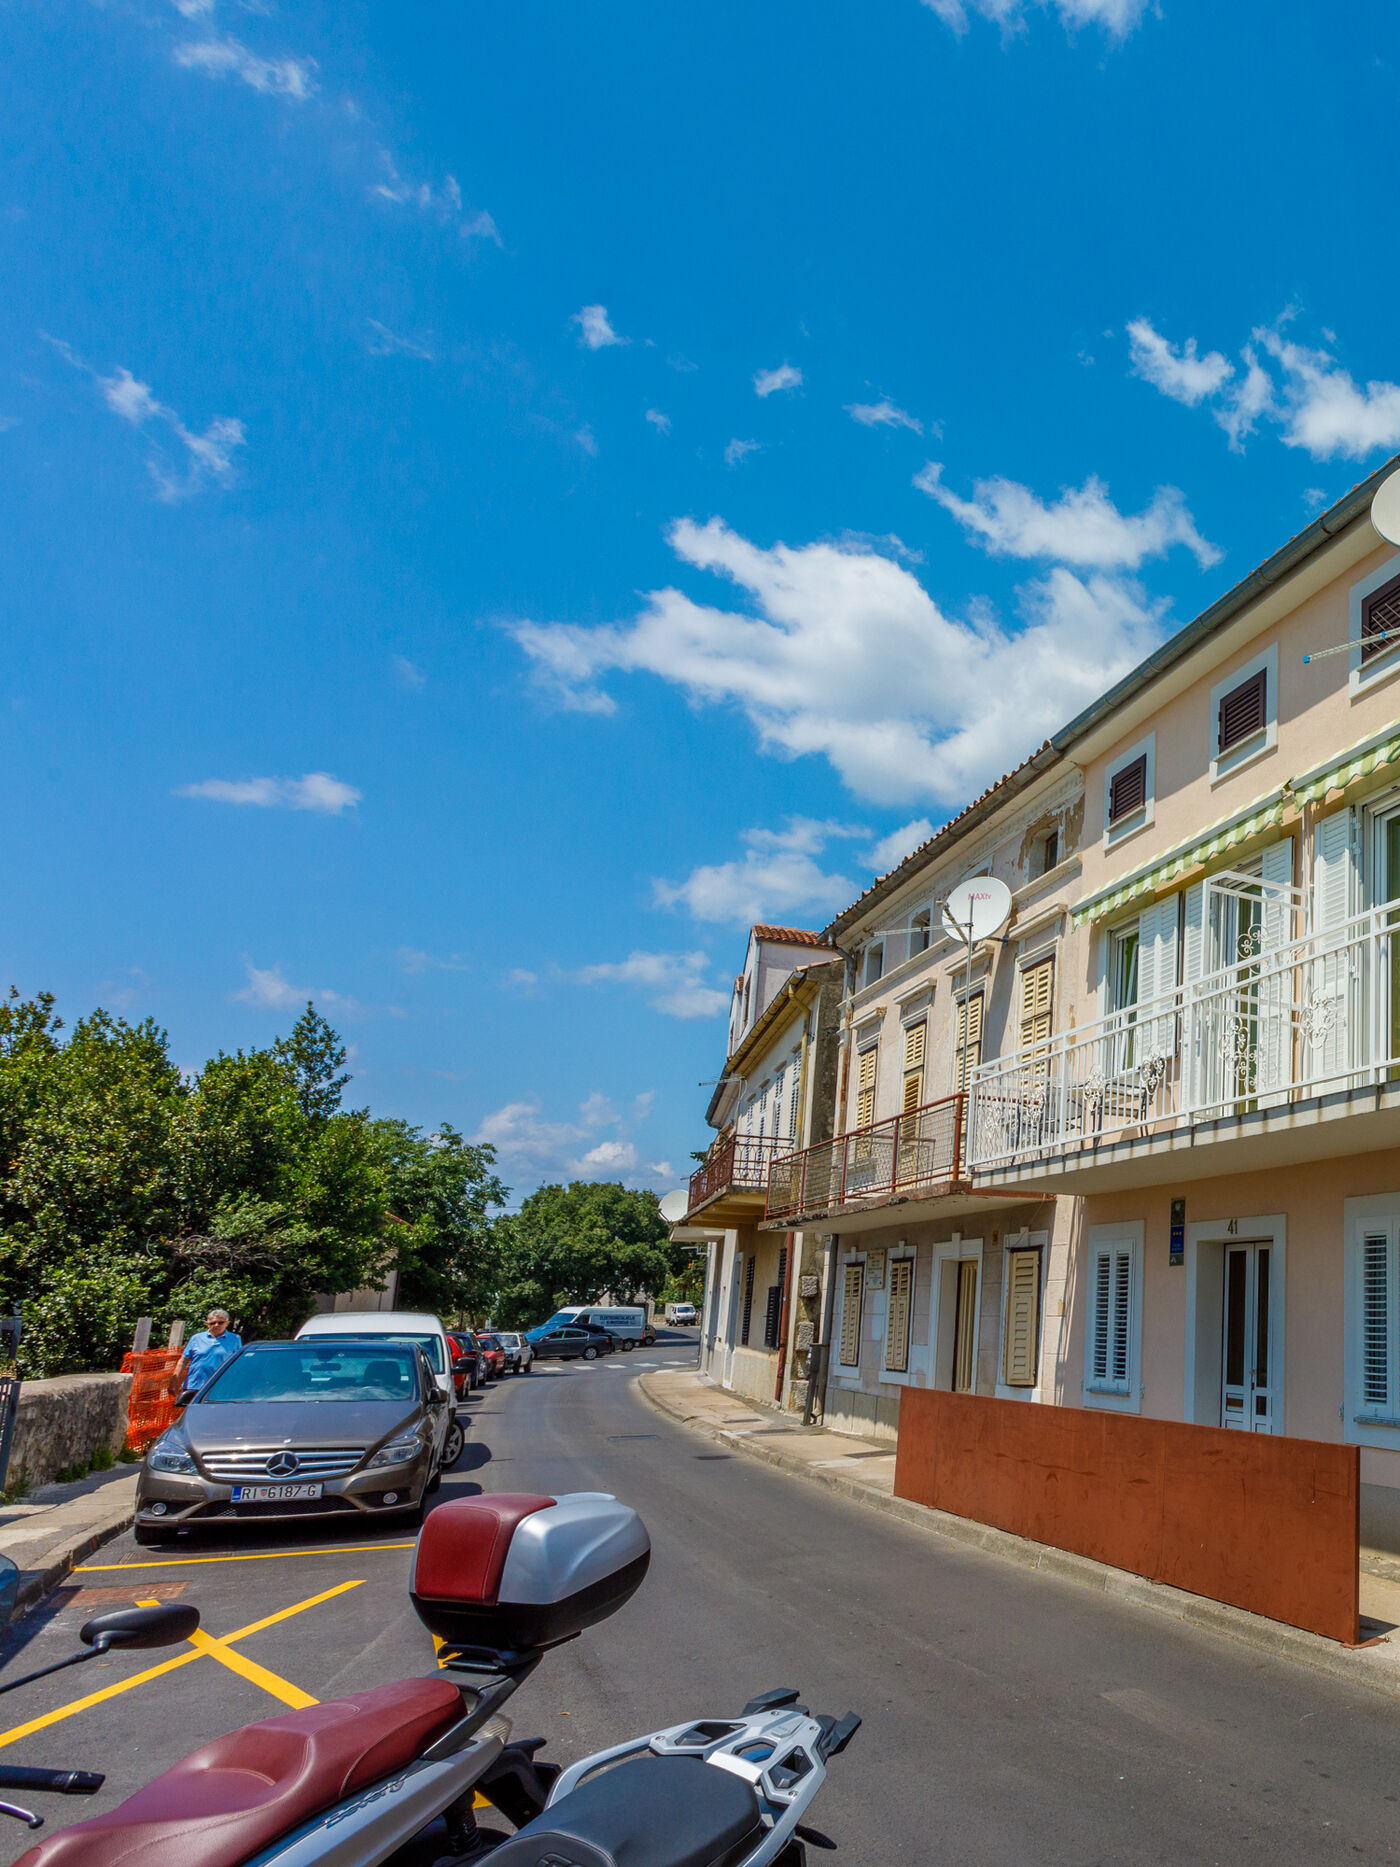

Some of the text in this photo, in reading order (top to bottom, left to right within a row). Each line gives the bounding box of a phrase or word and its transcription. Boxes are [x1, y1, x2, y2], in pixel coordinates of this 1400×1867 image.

[1227, 1218, 1238, 1234] 41
[242, 1485, 317, 1499] RI 6187-G
